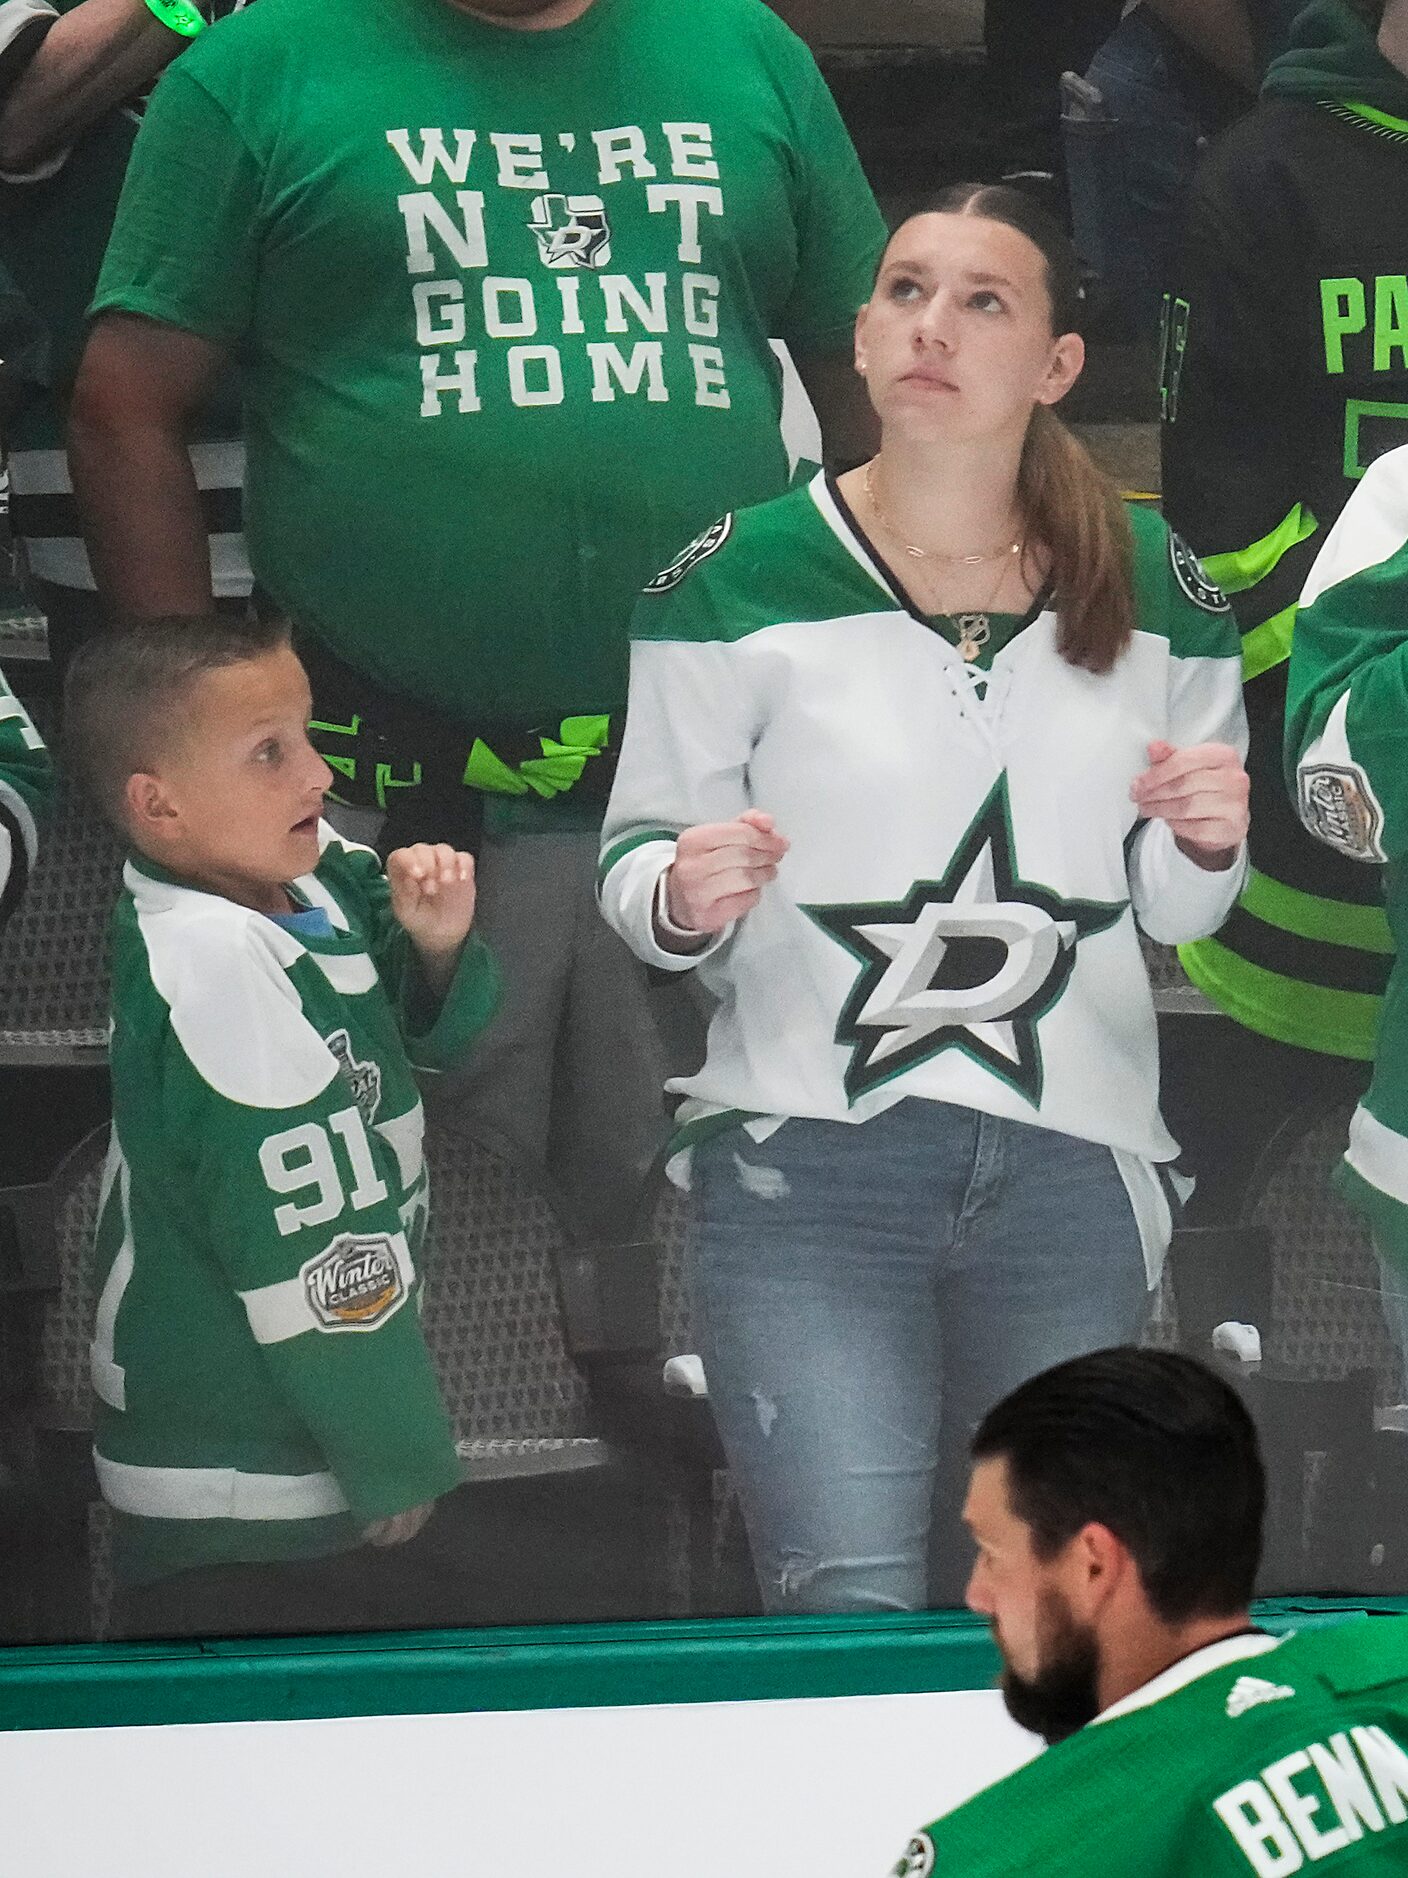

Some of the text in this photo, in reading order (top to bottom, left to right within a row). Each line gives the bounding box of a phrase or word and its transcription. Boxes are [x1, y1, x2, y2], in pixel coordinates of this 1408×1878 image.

[385, 122, 720, 190] WE'RE
[411, 272, 720, 346] GOING
[420, 342, 731, 417] HOME
[258, 1105, 388, 1236] 91
[306, 1252, 394, 1307] Winter
